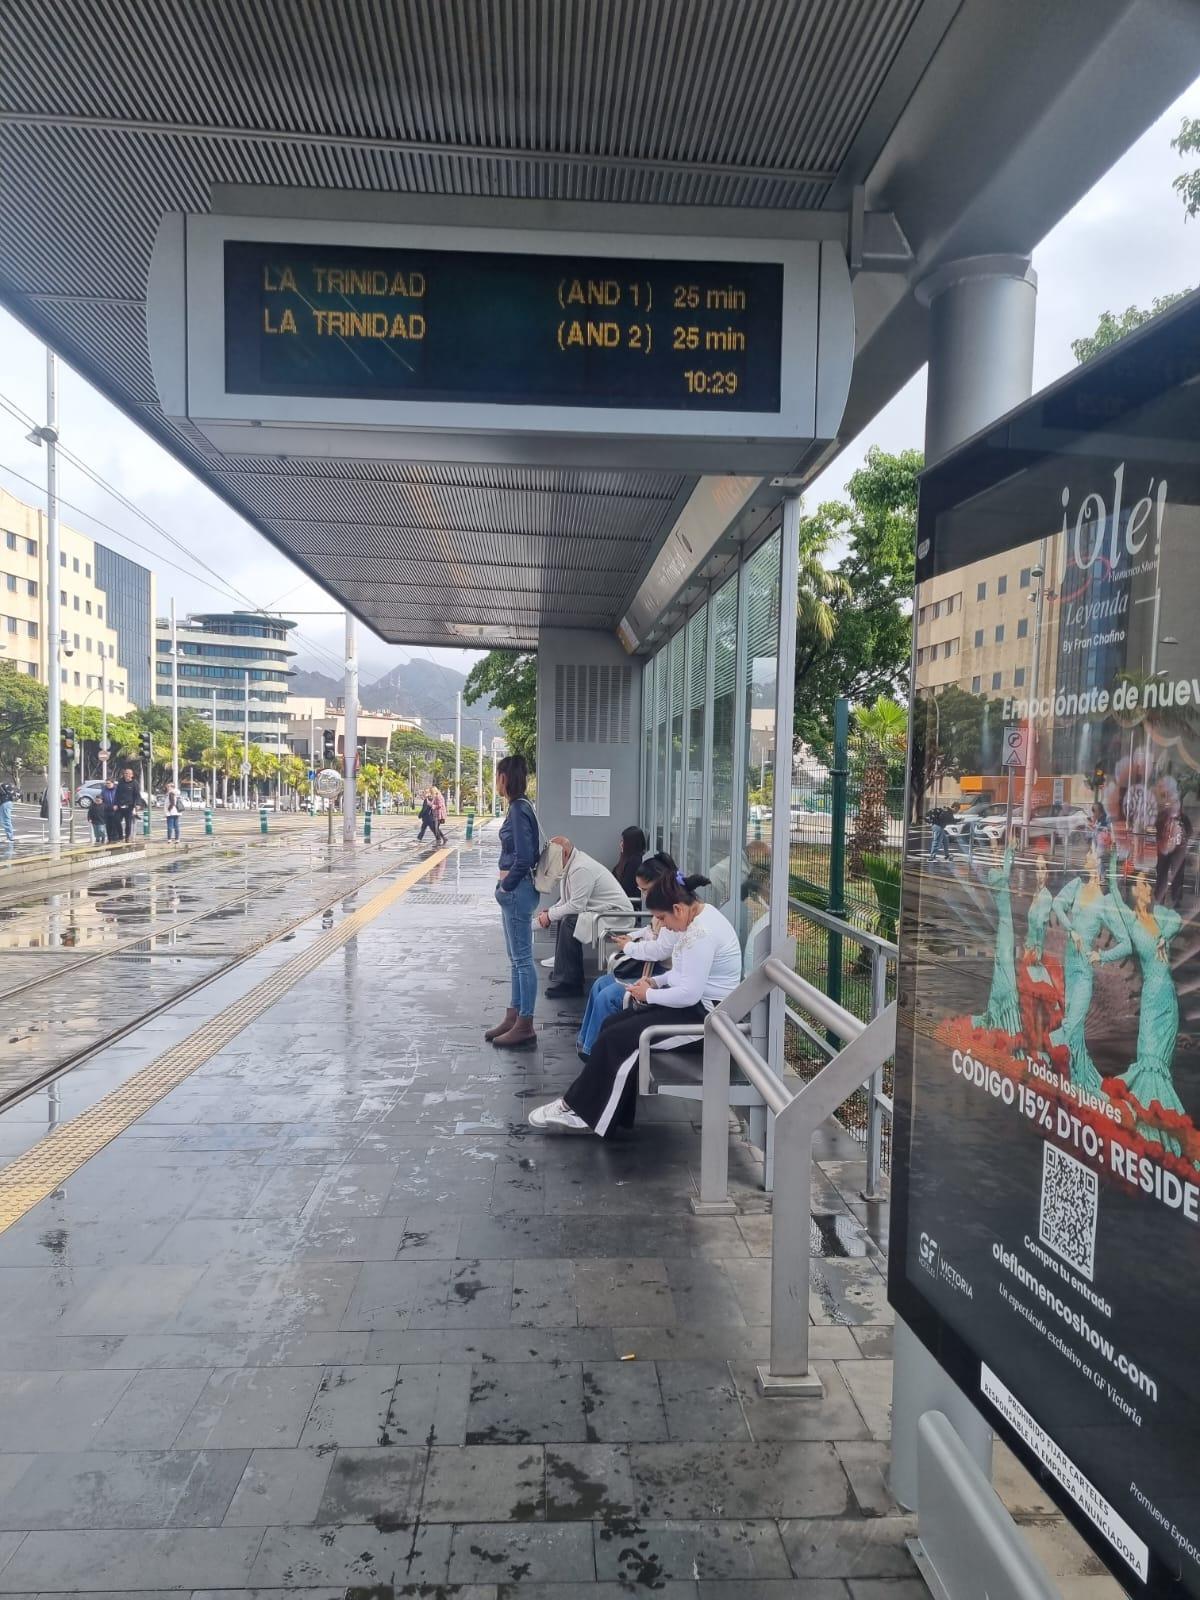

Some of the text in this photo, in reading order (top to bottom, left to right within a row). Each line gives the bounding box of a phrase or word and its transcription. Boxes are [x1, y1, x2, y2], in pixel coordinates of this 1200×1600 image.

[264, 265, 296, 291] LA
[313, 268, 426, 297] TRINIDAD
[558, 280, 621, 309] (AND
[673, 285, 700, 309] 25
[707, 285, 746, 310] min
[264, 307, 297, 334] LA
[313, 309, 426, 339] TRINIDAD
[557, 320, 621, 350] (AND
[673, 326, 700, 350] 25
[706, 327, 745, 351] min
[684, 370, 738, 394] 10:29
[1066, 590, 1128, 629] Leyenda
[1062, 640, 1074, 655] By
[1074, 637, 1092, 651] Fran
[1002, 685, 1109, 721] Emociónate
[1112, 680, 1139, 711] de
[1027, 1056, 1122, 1123] Todos los jueves
[952, 1049, 1200, 1223] CÓDIGO 15% DTO: RESIDE
[919, 1231, 938, 1265] GF
[941, 1257, 973, 1300] VICTORIA
[1024, 1234, 1113, 1318] Compra tu entrada
[1008, 1293, 1047, 1336] espectáculo
[1047, 1330, 1082, 1368] exclusivo
[1082, 1364, 1093, 1381] en
[1093, 1371, 1107, 1391] GF
[1107, 1382, 1143, 1427] Victoria
[1008, 1394, 1109, 1516] PROHIBIDO FIJAR CARTELES
[984, 1383, 1142, 1574] RESPONSABLE LA EMPRESA ANUNCIADORA
[1130, 1481, 1171, 1531] Promueve
